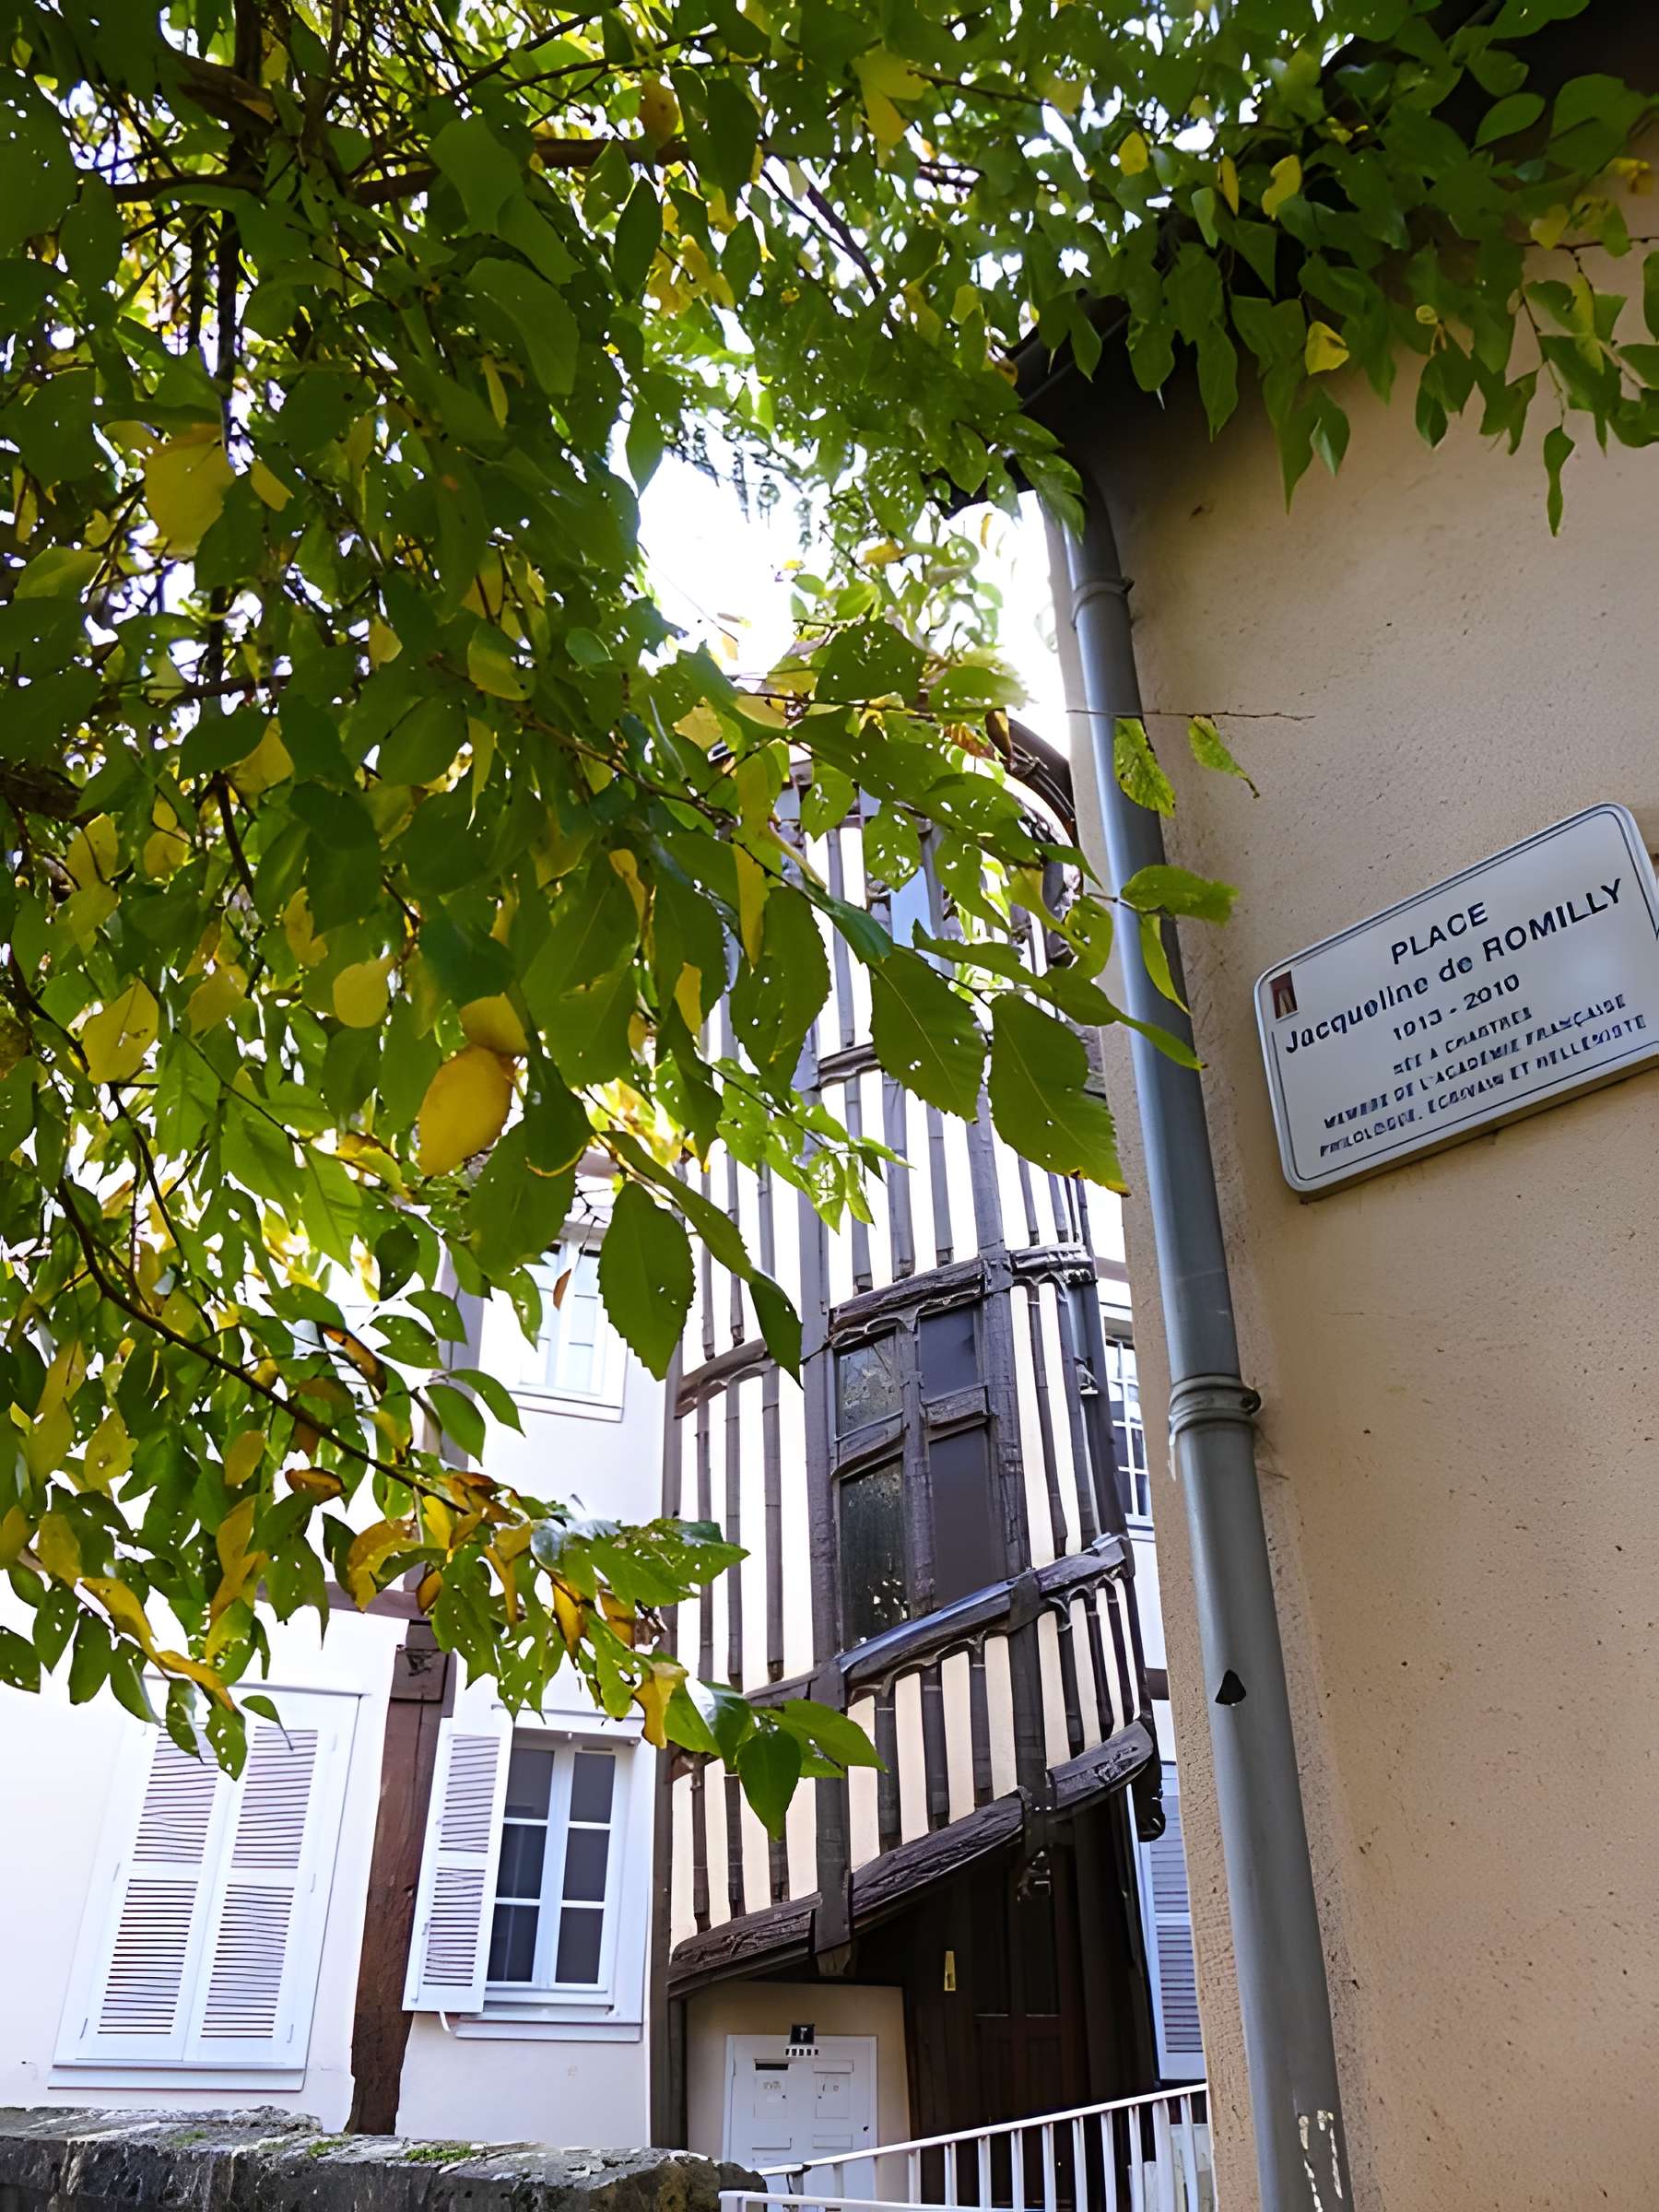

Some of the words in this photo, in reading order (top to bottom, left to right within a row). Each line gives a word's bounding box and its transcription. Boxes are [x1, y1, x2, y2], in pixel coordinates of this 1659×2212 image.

[1391, 902, 1488, 965] PLACE
[1286, 977, 1429, 1053] Jacqueline
[1482, 878, 1621, 962] ROMILLY
[1464, 973, 1520, 1011] 2010
